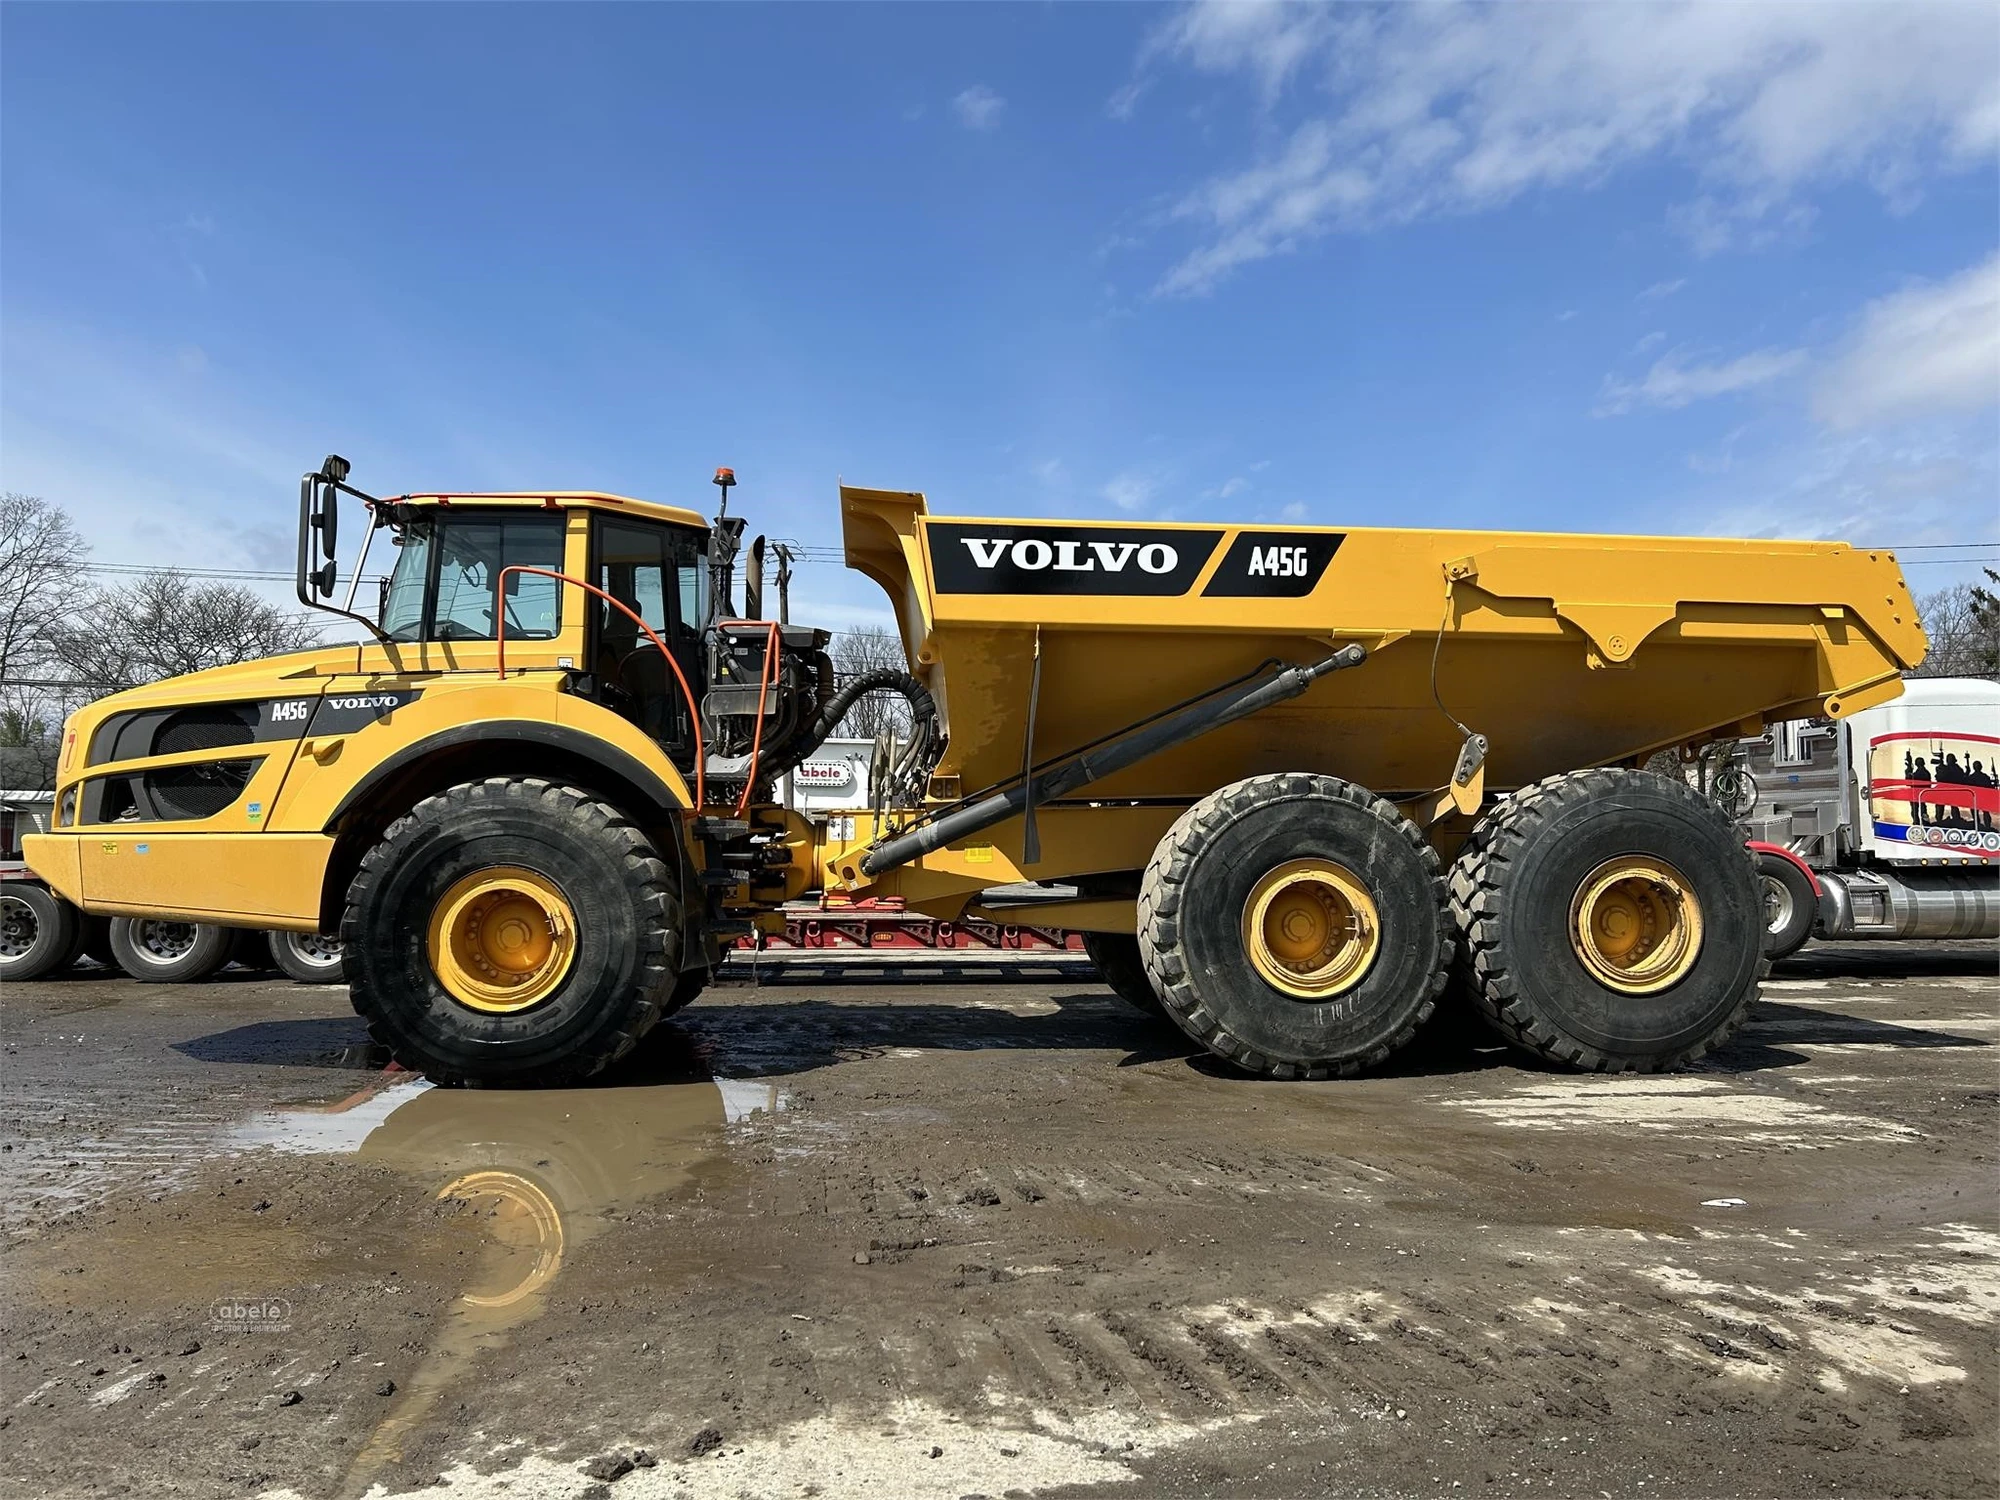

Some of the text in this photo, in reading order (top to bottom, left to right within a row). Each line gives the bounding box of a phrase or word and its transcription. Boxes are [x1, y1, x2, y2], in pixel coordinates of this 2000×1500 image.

[960, 538, 1179, 574] VOLVO
[1247, 546, 1307, 577] A45G
[271, 701, 307, 721] A45G
[328, 696, 399, 710] VOLVO
[801, 766, 841, 778] abele
